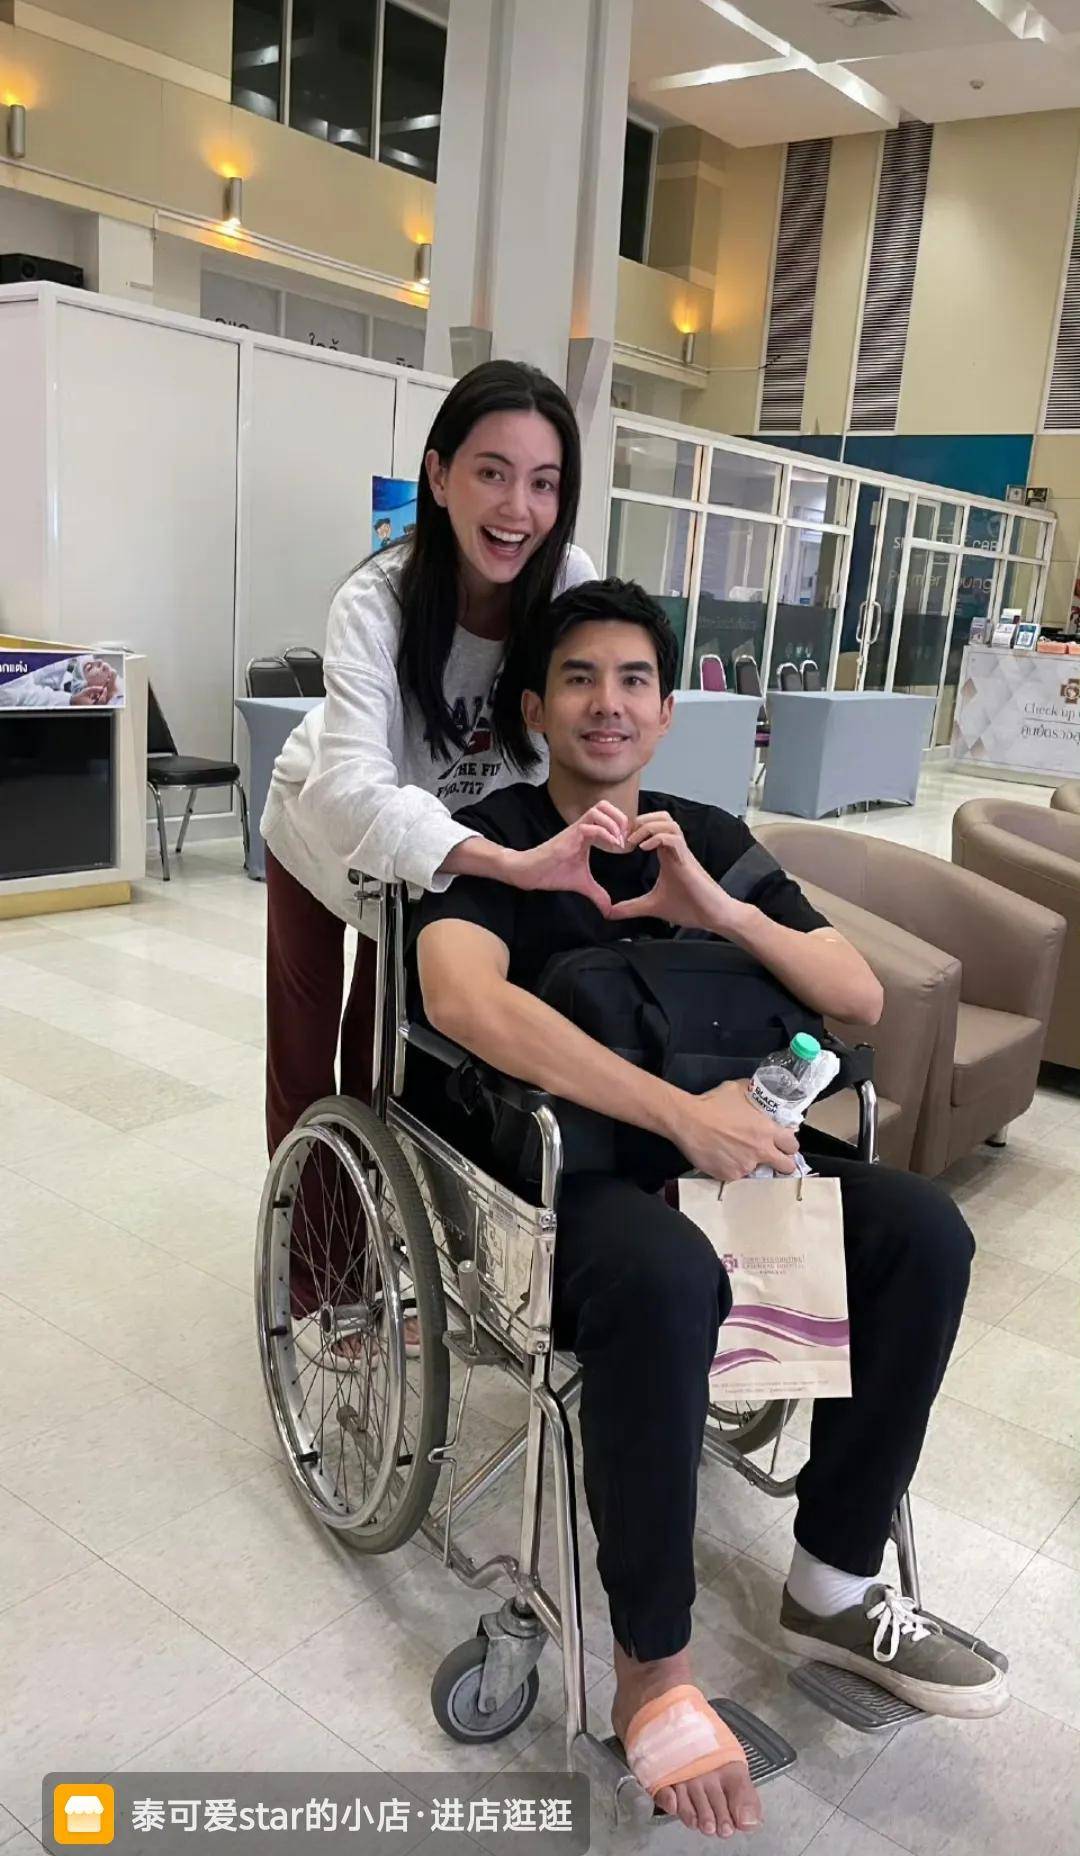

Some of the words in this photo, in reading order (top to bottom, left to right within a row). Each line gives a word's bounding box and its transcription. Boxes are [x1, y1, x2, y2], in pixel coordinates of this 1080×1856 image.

[0, 660, 28, 674] กแต่ง
[1024, 702, 1058, 717] Check
[1061, 707, 1076, 722] up
[752, 1092, 777, 1114] CANYON
[755, 1086, 780, 1109] BLACK
